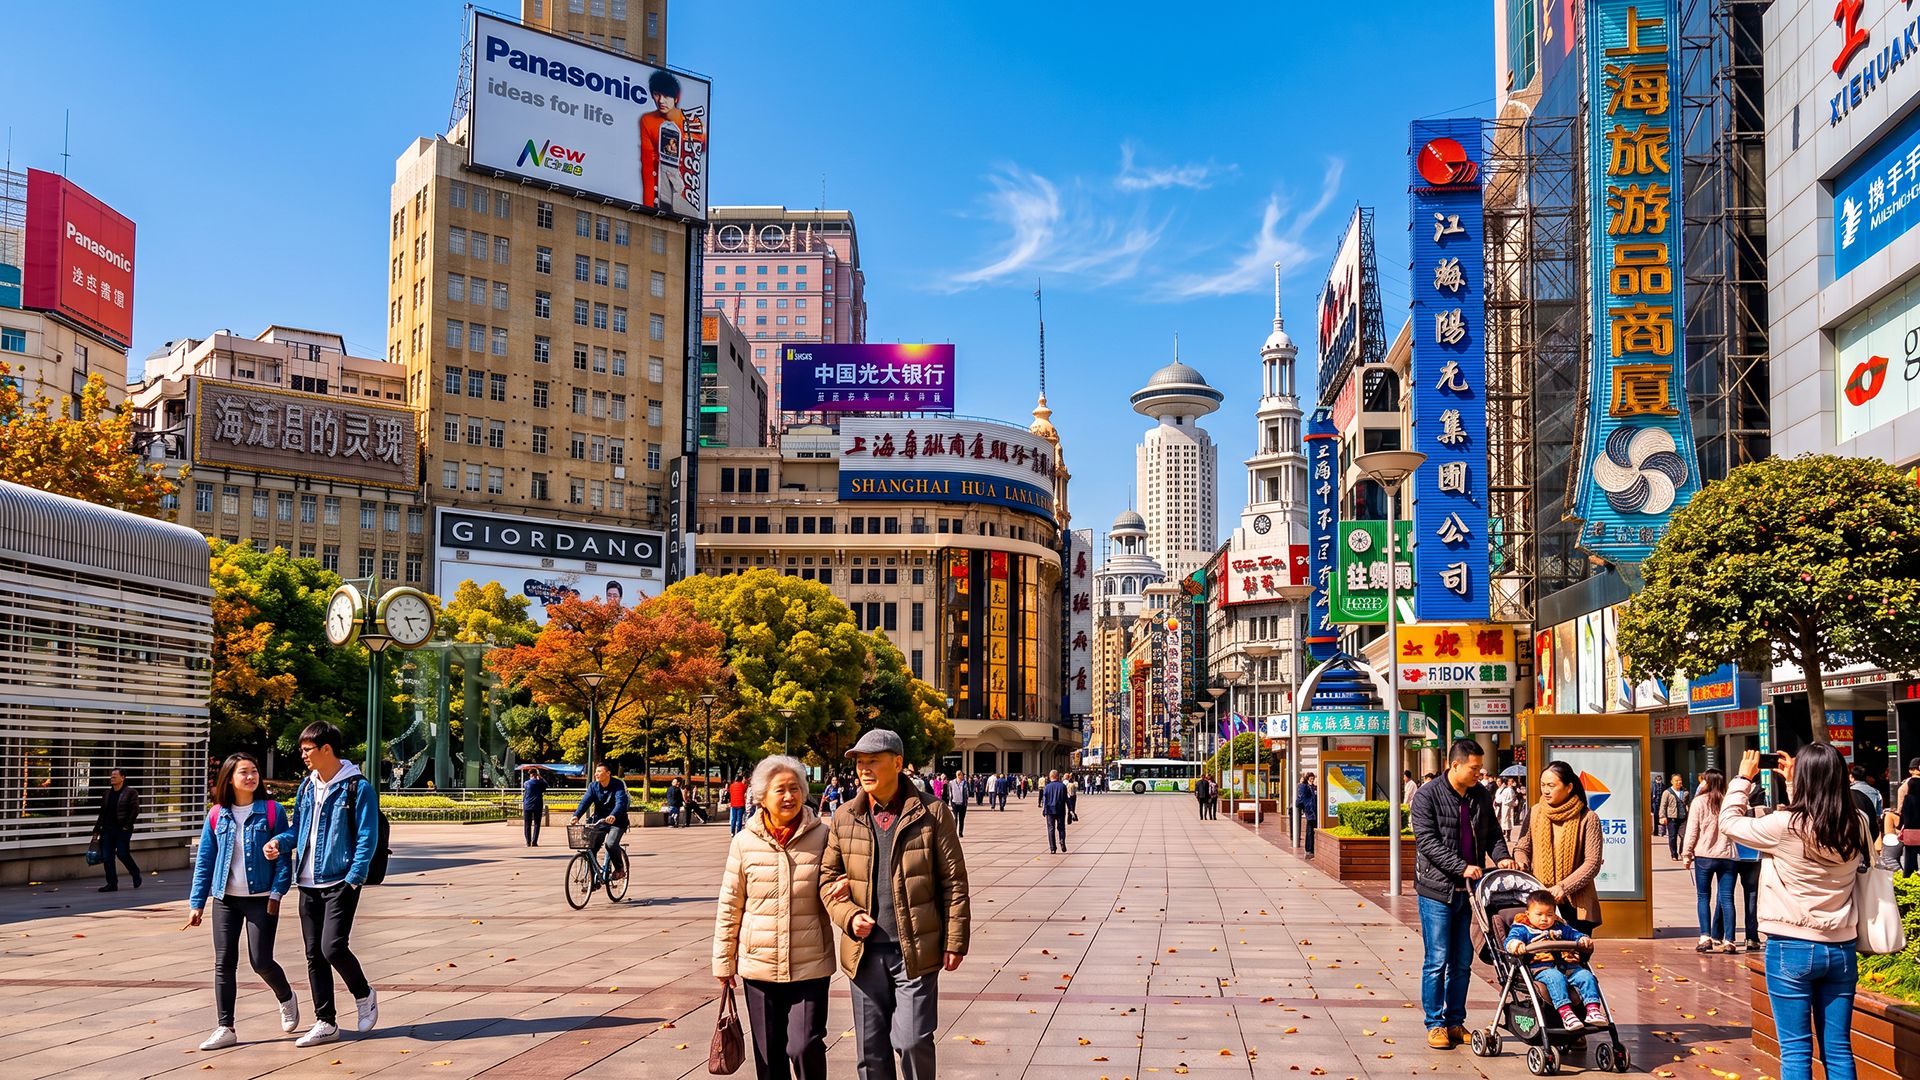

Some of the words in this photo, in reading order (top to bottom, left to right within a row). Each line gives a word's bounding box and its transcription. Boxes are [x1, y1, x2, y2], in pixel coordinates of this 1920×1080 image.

[486, 35, 648, 105] Panasonic
[488, 77, 545, 107] ideas
[550, 94, 579, 119] for
[583, 103, 614, 127] life
[516, 139, 586, 167] New
[66, 221, 132, 273] Panasonic
[815, 362, 945, 386] 中国光大银行
[851, 478, 949, 494] SHANGHAI
[961, 480, 996, 498] HUA
[452, 522, 653, 559] GIORDANO
